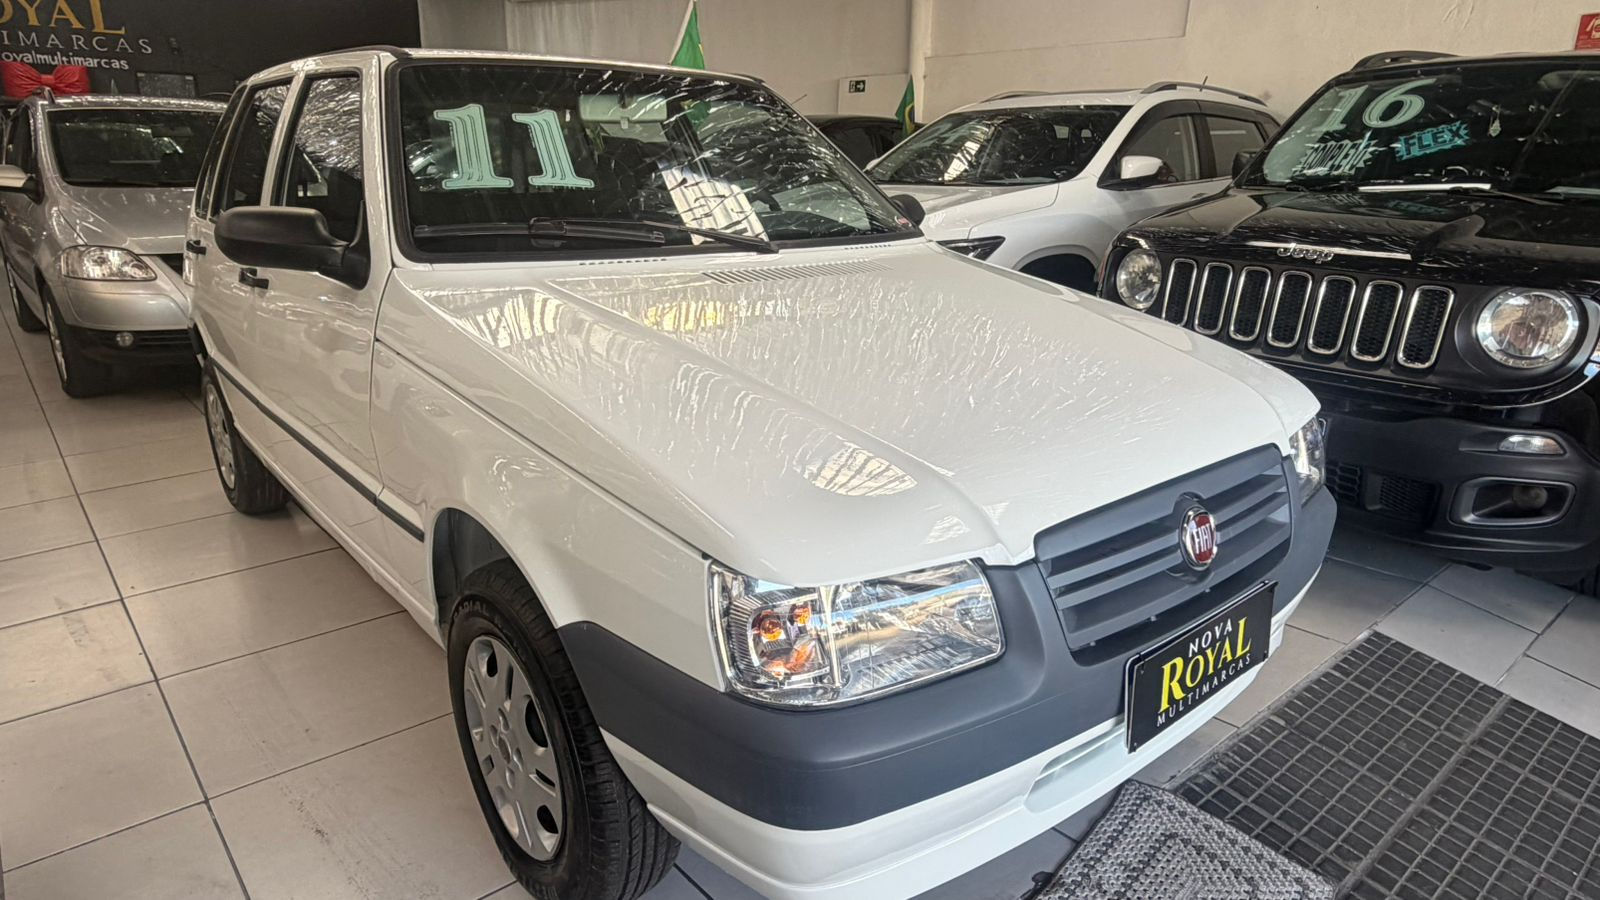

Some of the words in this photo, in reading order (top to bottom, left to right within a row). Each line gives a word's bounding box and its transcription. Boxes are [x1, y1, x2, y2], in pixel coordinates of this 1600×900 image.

[1312, 78, 1437, 132] 16
[433, 103, 595, 190] 11
[1403, 126, 1467, 156] FLEX
[1277, 243, 1334, 265] Jeep
[1193, 523, 1214, 555] FIAT
[1188, 617, 1233, 658] NOVA
[1158, 616, 1252, 714] ROYAL
[1156, 653, 1251, 727] MULTIMARCAS
